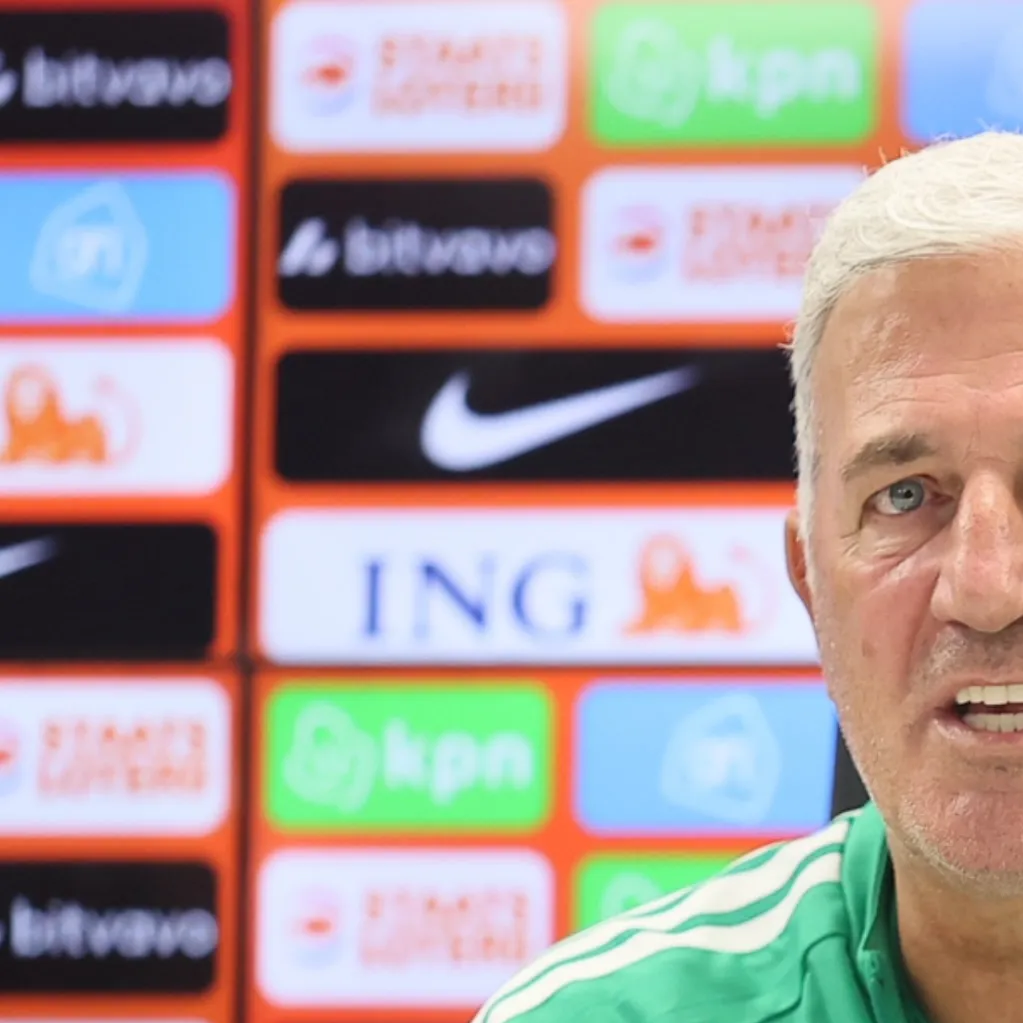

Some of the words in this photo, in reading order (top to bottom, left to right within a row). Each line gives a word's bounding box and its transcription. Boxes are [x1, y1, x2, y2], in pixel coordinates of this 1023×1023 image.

[704, 35, 862, 118] kpn
[363, 553, 590, 643] ING
[382, 717, 534, 805] kpn
